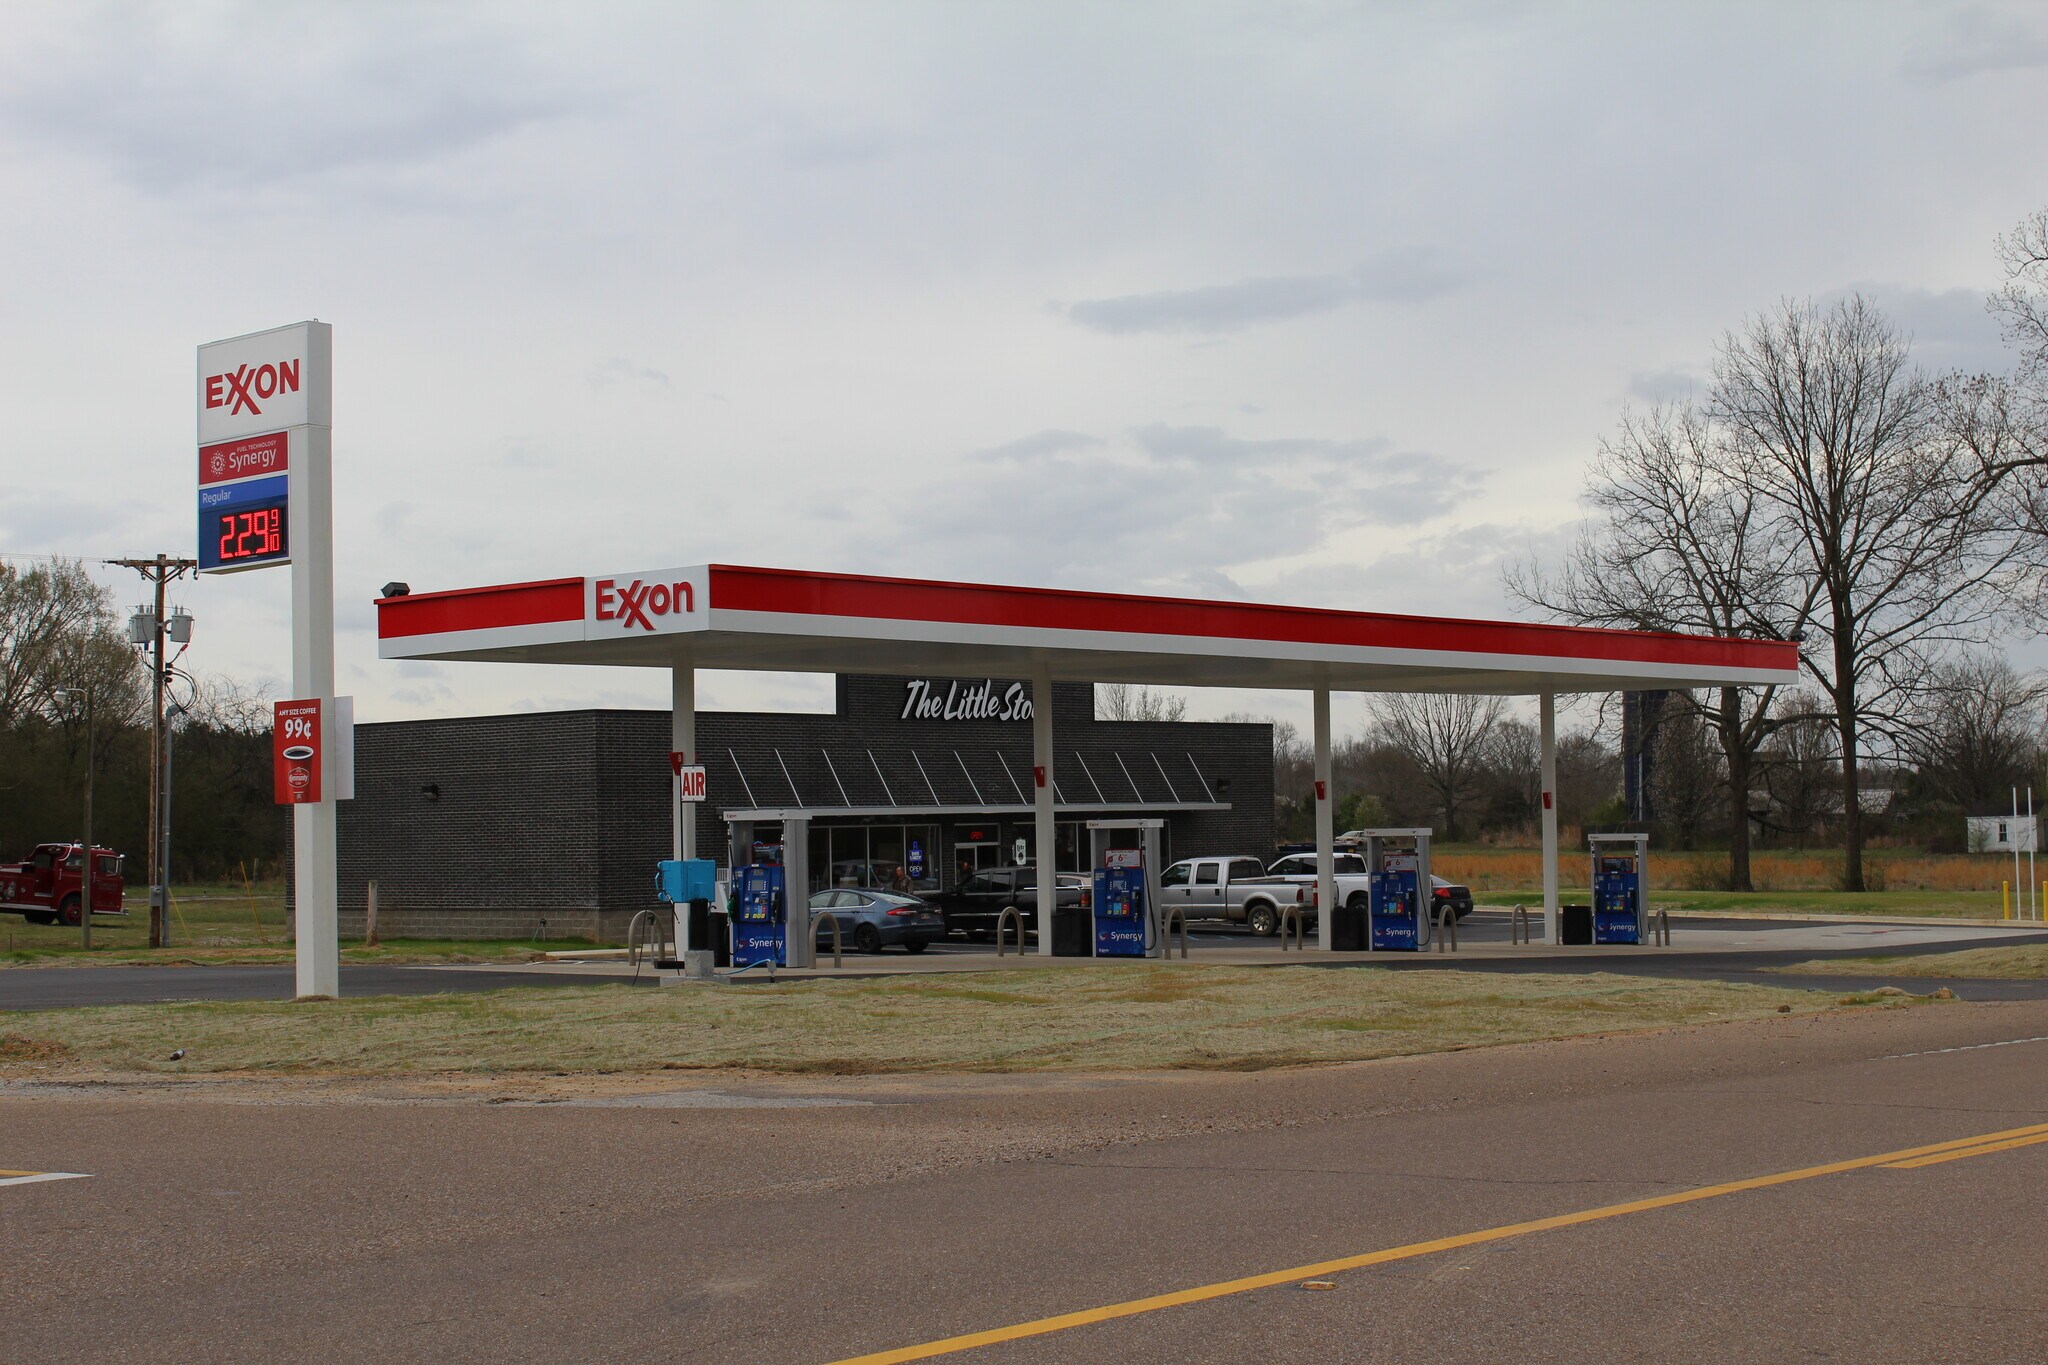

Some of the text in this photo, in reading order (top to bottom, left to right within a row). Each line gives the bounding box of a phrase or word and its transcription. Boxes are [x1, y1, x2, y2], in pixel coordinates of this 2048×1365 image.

[206, 358, 299, 415] EXXON
[248, 440, 277, 451] TECHNOLOGY
[228, 447, 277, 472] Synergy
[202, 489, 232, 506] Regular
[595, 578, 695, 632] Exxon
[901, 678, 1035, 722] The Little Sto
[300, 707, 316, 715] COFFEE
[284, 719, 312, 740] 99¢
[682, 772, 705, 796] AIR
[909, 865, 923, 873] OPEN
[1110, 931, 1143, 941] Synergy
